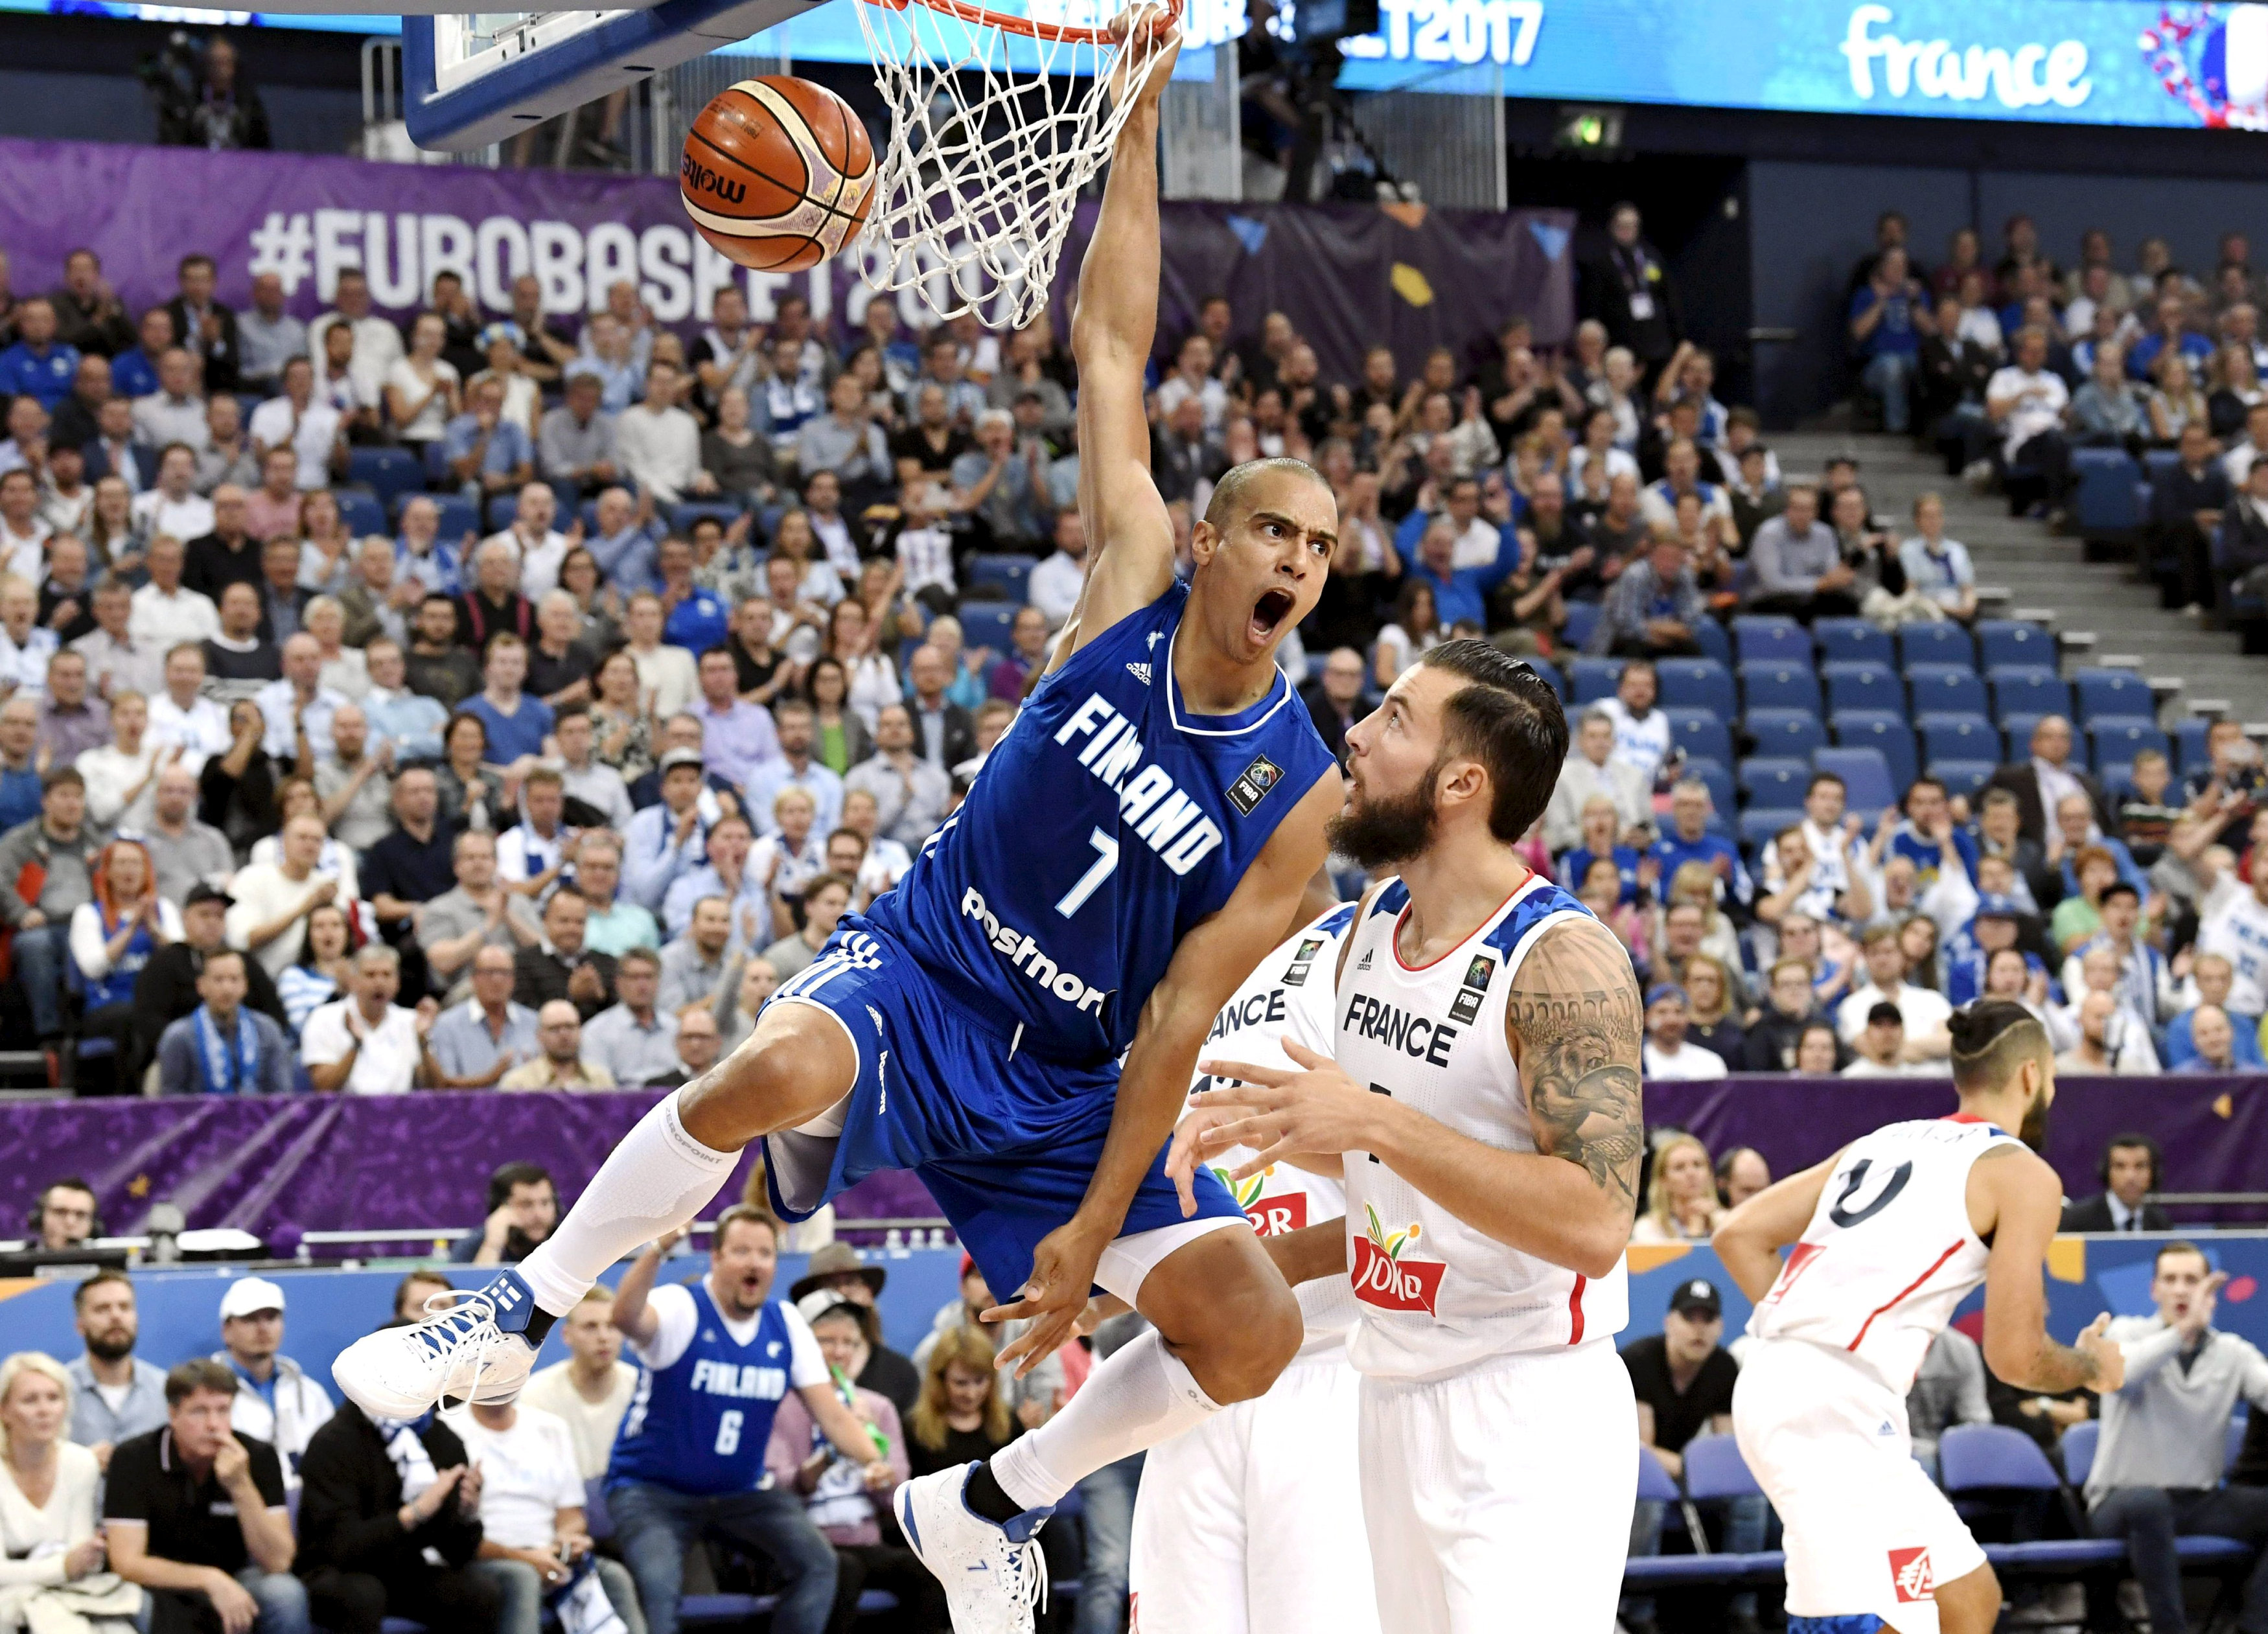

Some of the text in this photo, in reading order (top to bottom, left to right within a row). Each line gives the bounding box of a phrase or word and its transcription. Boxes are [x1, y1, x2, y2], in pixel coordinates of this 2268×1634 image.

[1838, 4, 2093, 109] france
[1054, 692, 1223, 876] FINAND
[1238, 781, 1258, 802] FIBA
[962, 886, 1118, 1018] postnor
[1203, 989, 1285, 1046] ANCE
[1458, 992, 1479, 1009] FIBA
[1343, 993, 1457, 1068] FRANCE
[665, 1104, 723, 1164] ZEROPOINT
[690, 1359, 787, 1401] FINLAND
[714, 1409, 745, 1456] 6
